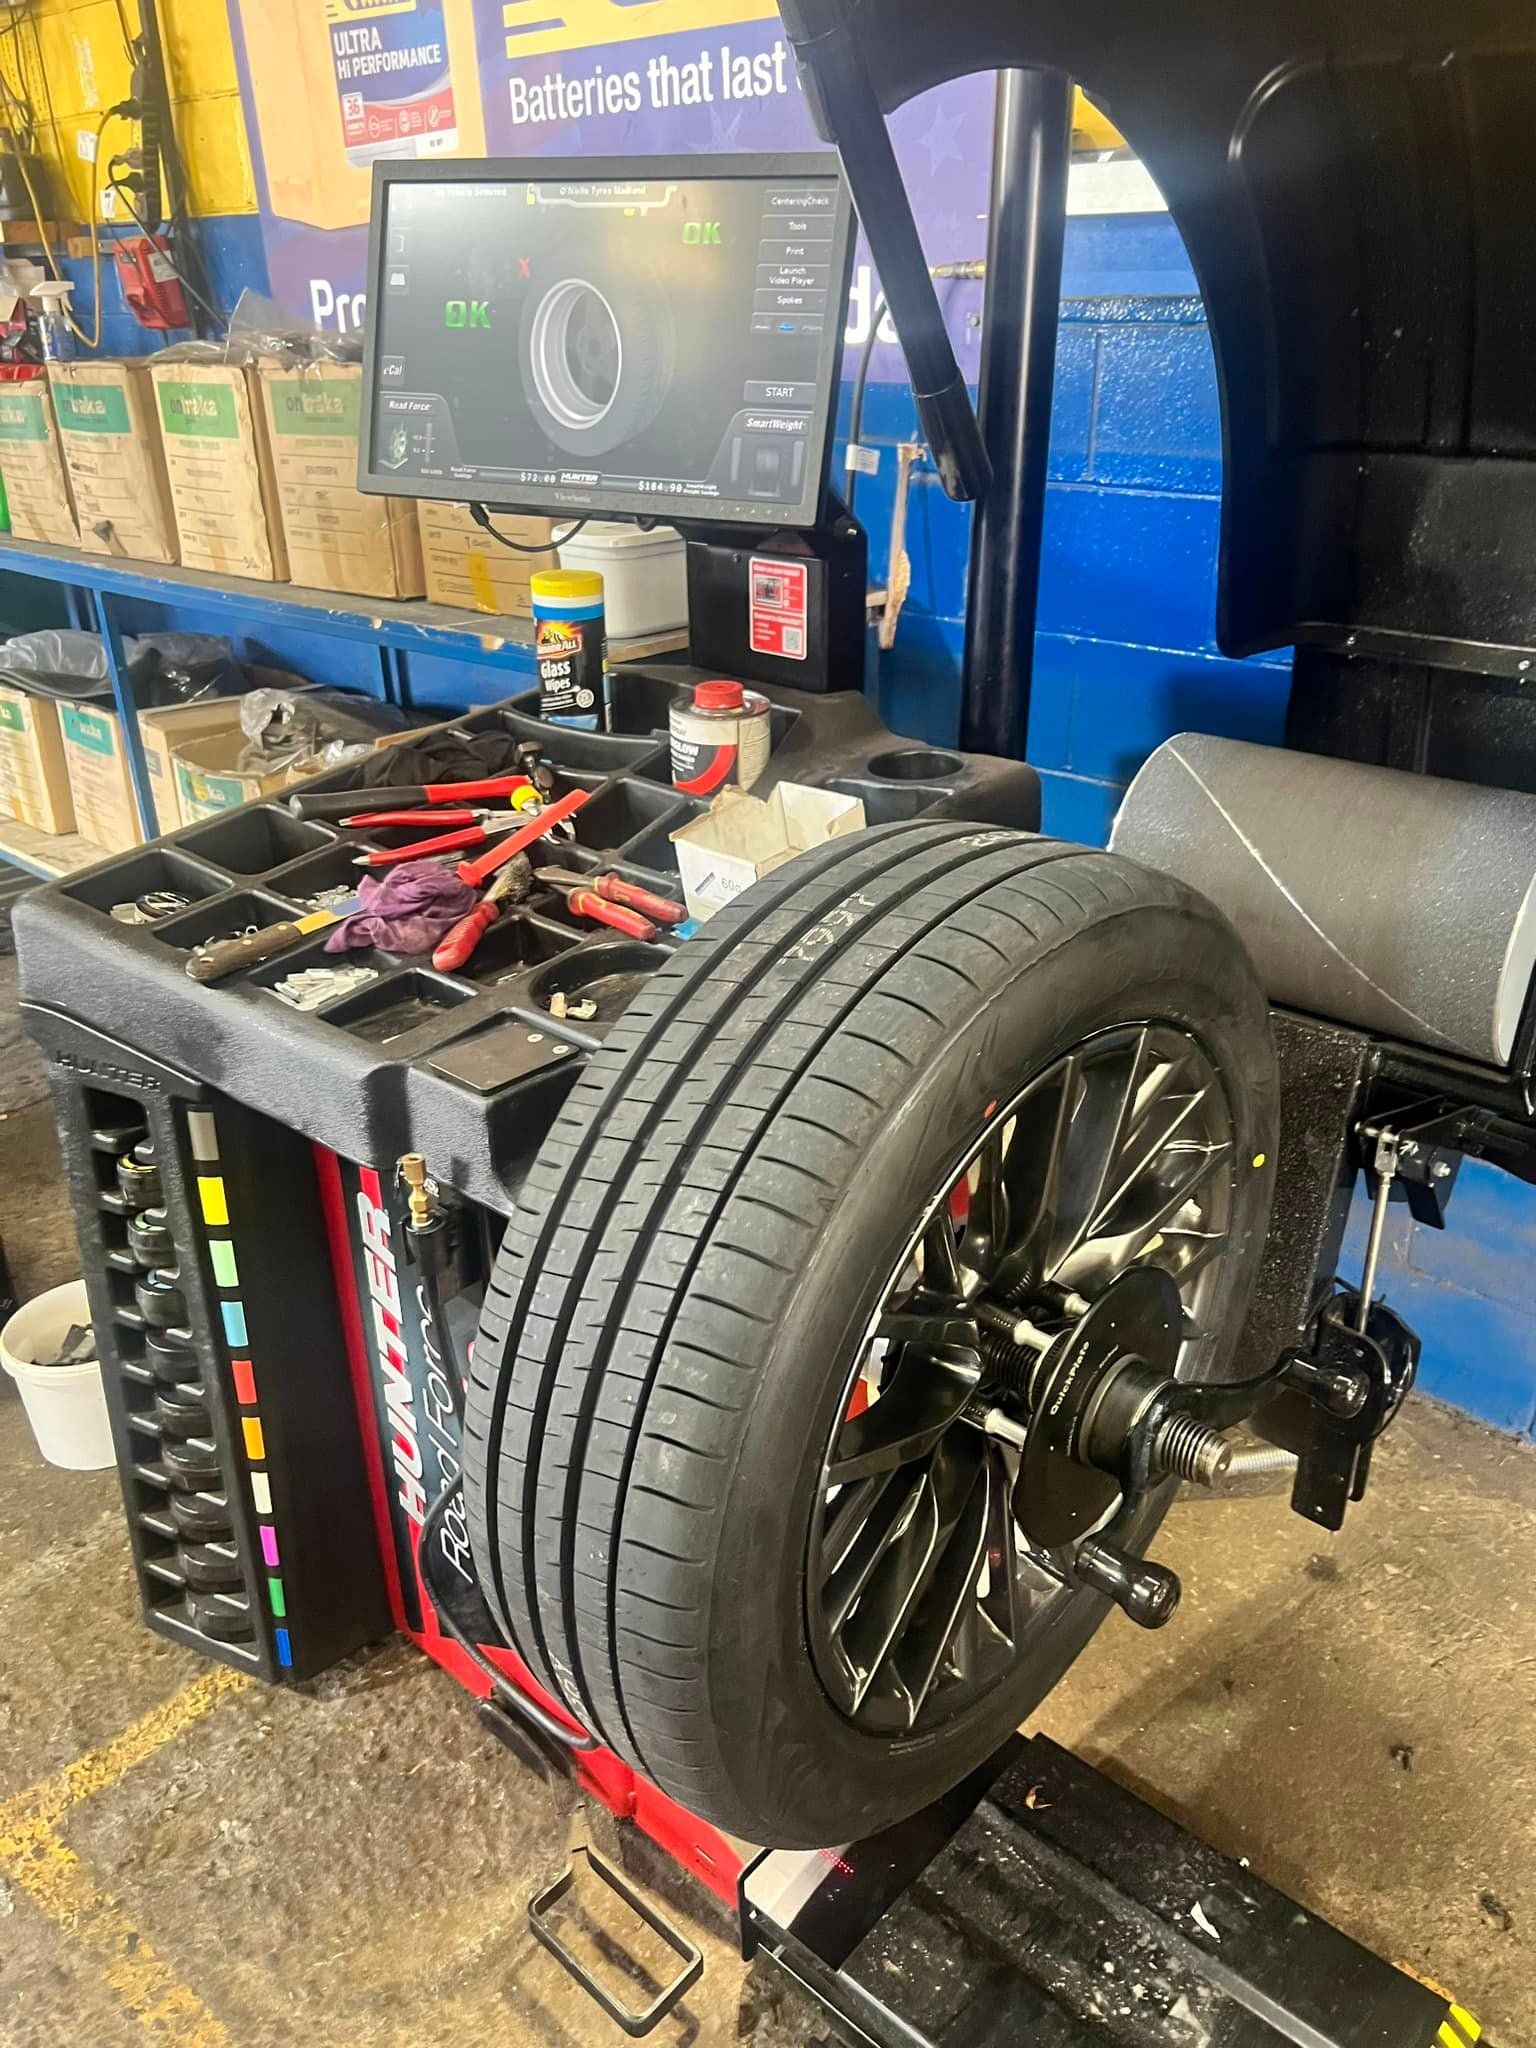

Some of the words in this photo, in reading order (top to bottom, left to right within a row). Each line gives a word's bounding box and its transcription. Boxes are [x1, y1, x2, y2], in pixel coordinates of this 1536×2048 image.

[333, 26, 383, 57] ULTRA
[337, 59, 352, 80] Hi
[352, 44, 443, 78] PERFORMANCE
[508, 65, 642, 125] Batteries
[646, 51, 715, 109] that
[721, 41, 788, 100] last
[681, 221, 722, 244] OK
[788, 221, 807, 231] Tools
[786, 246, 805, 257] Print
[779, 266, 807, 276] Launch
[769, 276, 790, 285] Video
[791, 276, 815, 287] Player
[777, 295, 804, 306] Spokes
[445, 300, 492, 329] OK
[765, 387, 795, 398] START
[746, 418, 804, 432] SmartWeight
[560, 472, 599, 482] HUNTER
[540, 659, 572, 679] Glass
[544, 678, 572, 694] Wipes
[357, 1191, 428, 1528] HUNTER
